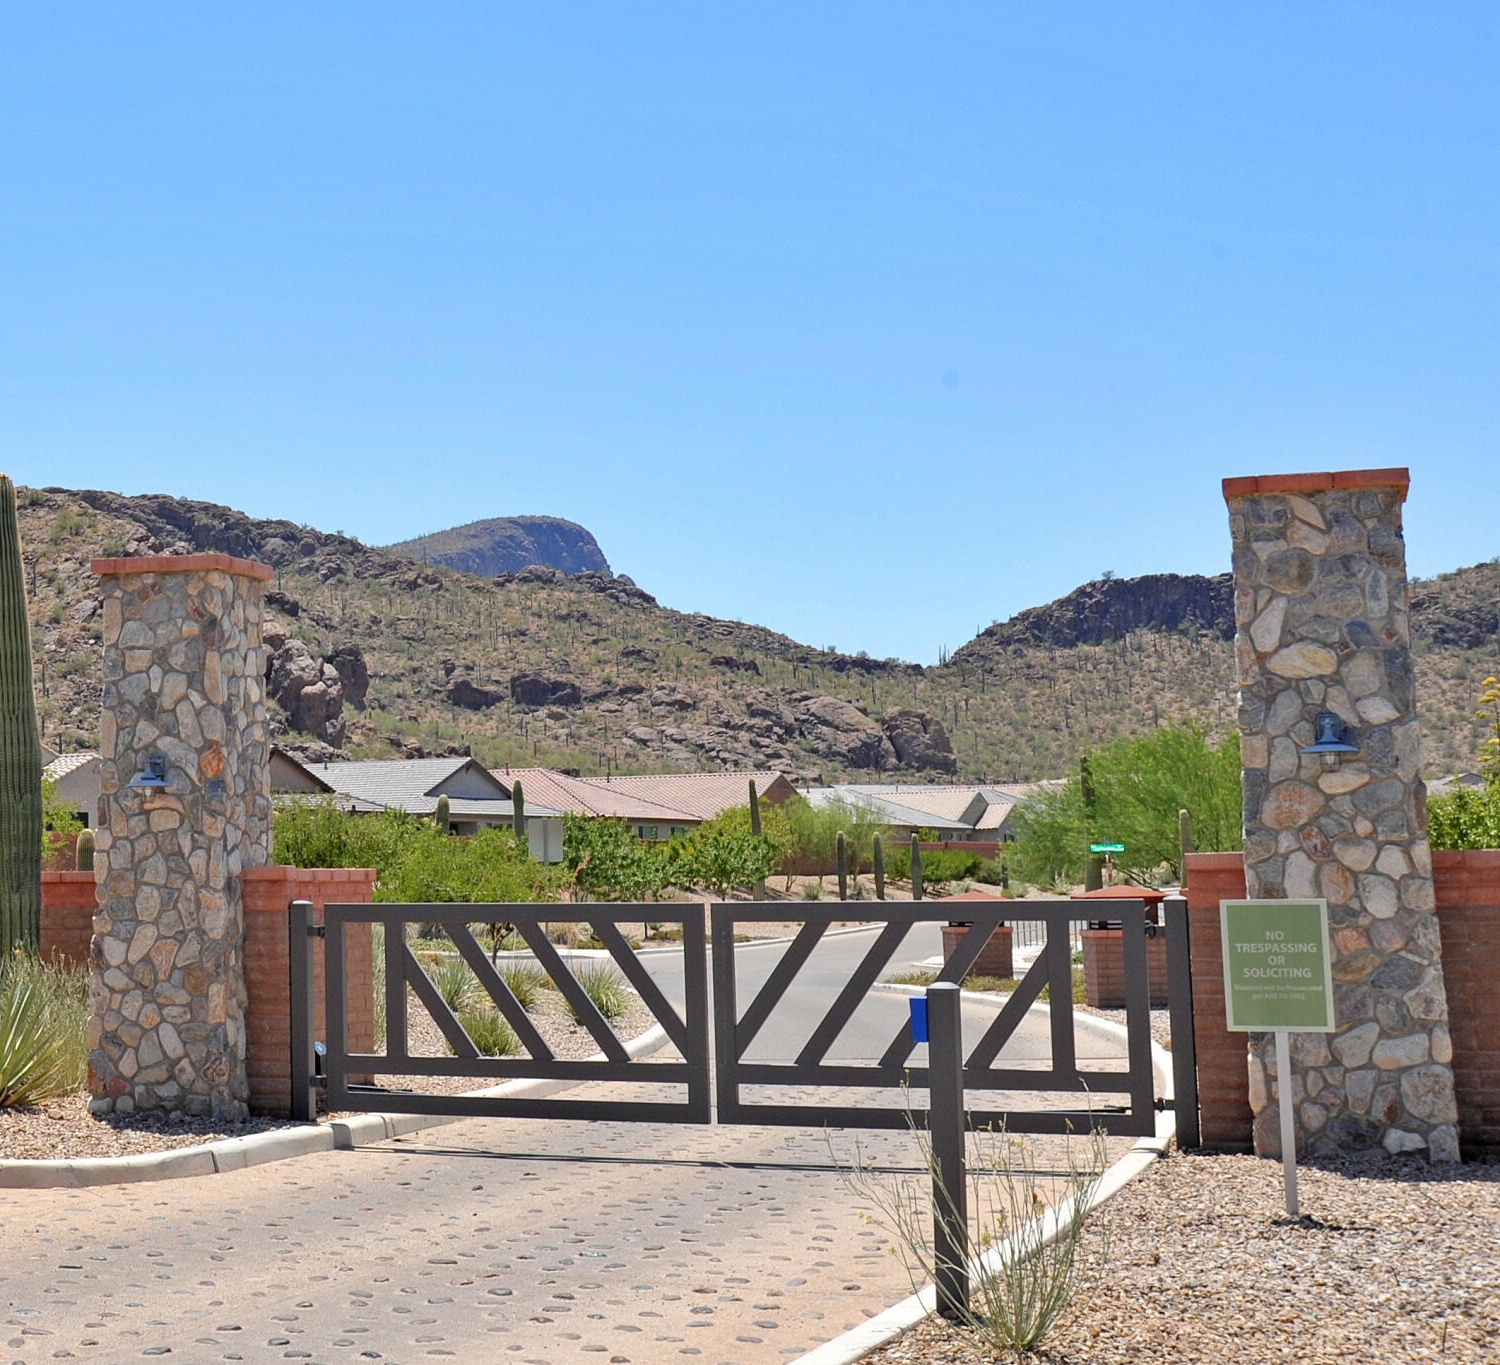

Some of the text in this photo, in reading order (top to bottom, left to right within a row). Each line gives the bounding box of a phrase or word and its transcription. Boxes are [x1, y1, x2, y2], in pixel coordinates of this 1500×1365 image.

[1265, 930, 1284, 940] NO
[1235, 943, 1317, 953] TRESPASSING
[1267, 955, 1285, 965] OR
[1243, 968, 1312, 978] SOLICITING
